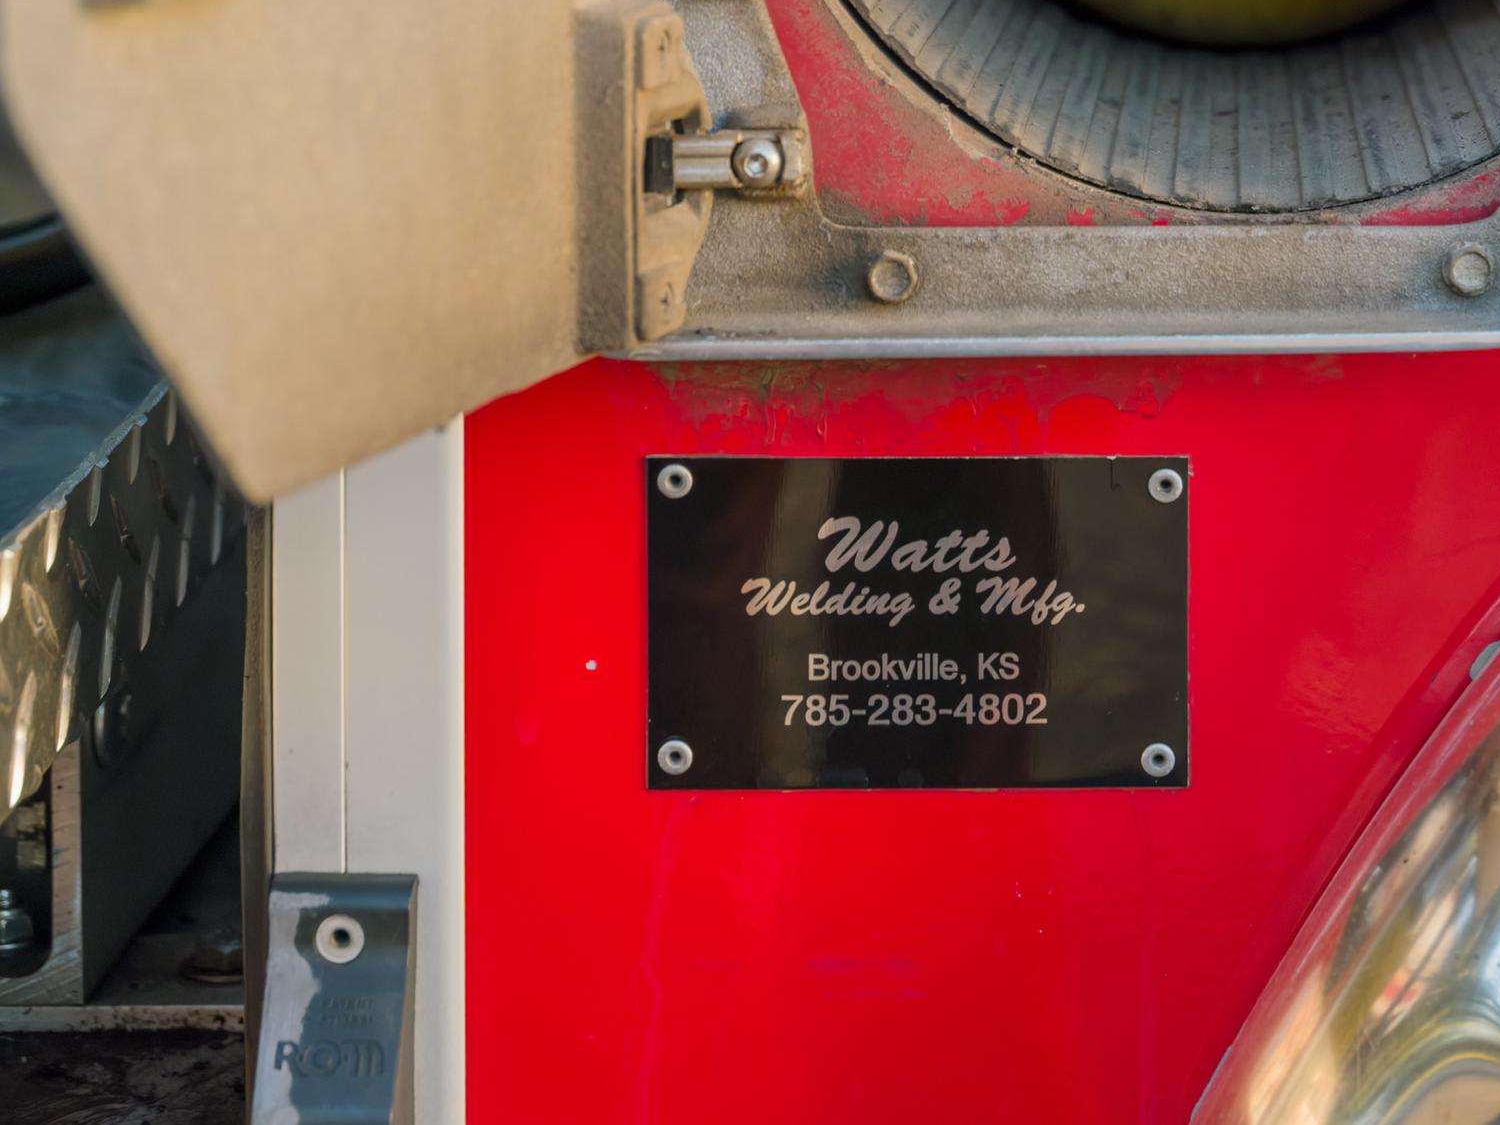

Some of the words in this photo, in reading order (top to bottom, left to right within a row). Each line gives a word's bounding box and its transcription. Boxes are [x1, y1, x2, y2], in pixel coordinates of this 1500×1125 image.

[818, 517, 1017, 573] Watts
[741, 577, 916, 627] Welding
[929, 578, 962, 615] &
[976, 577, 1086, 626] Mfg.
[808, 653, 967, 685] Brookville,
[979, 653, 1020, 680] KS
[781, 693, 1048, 727] 785-283-4802
